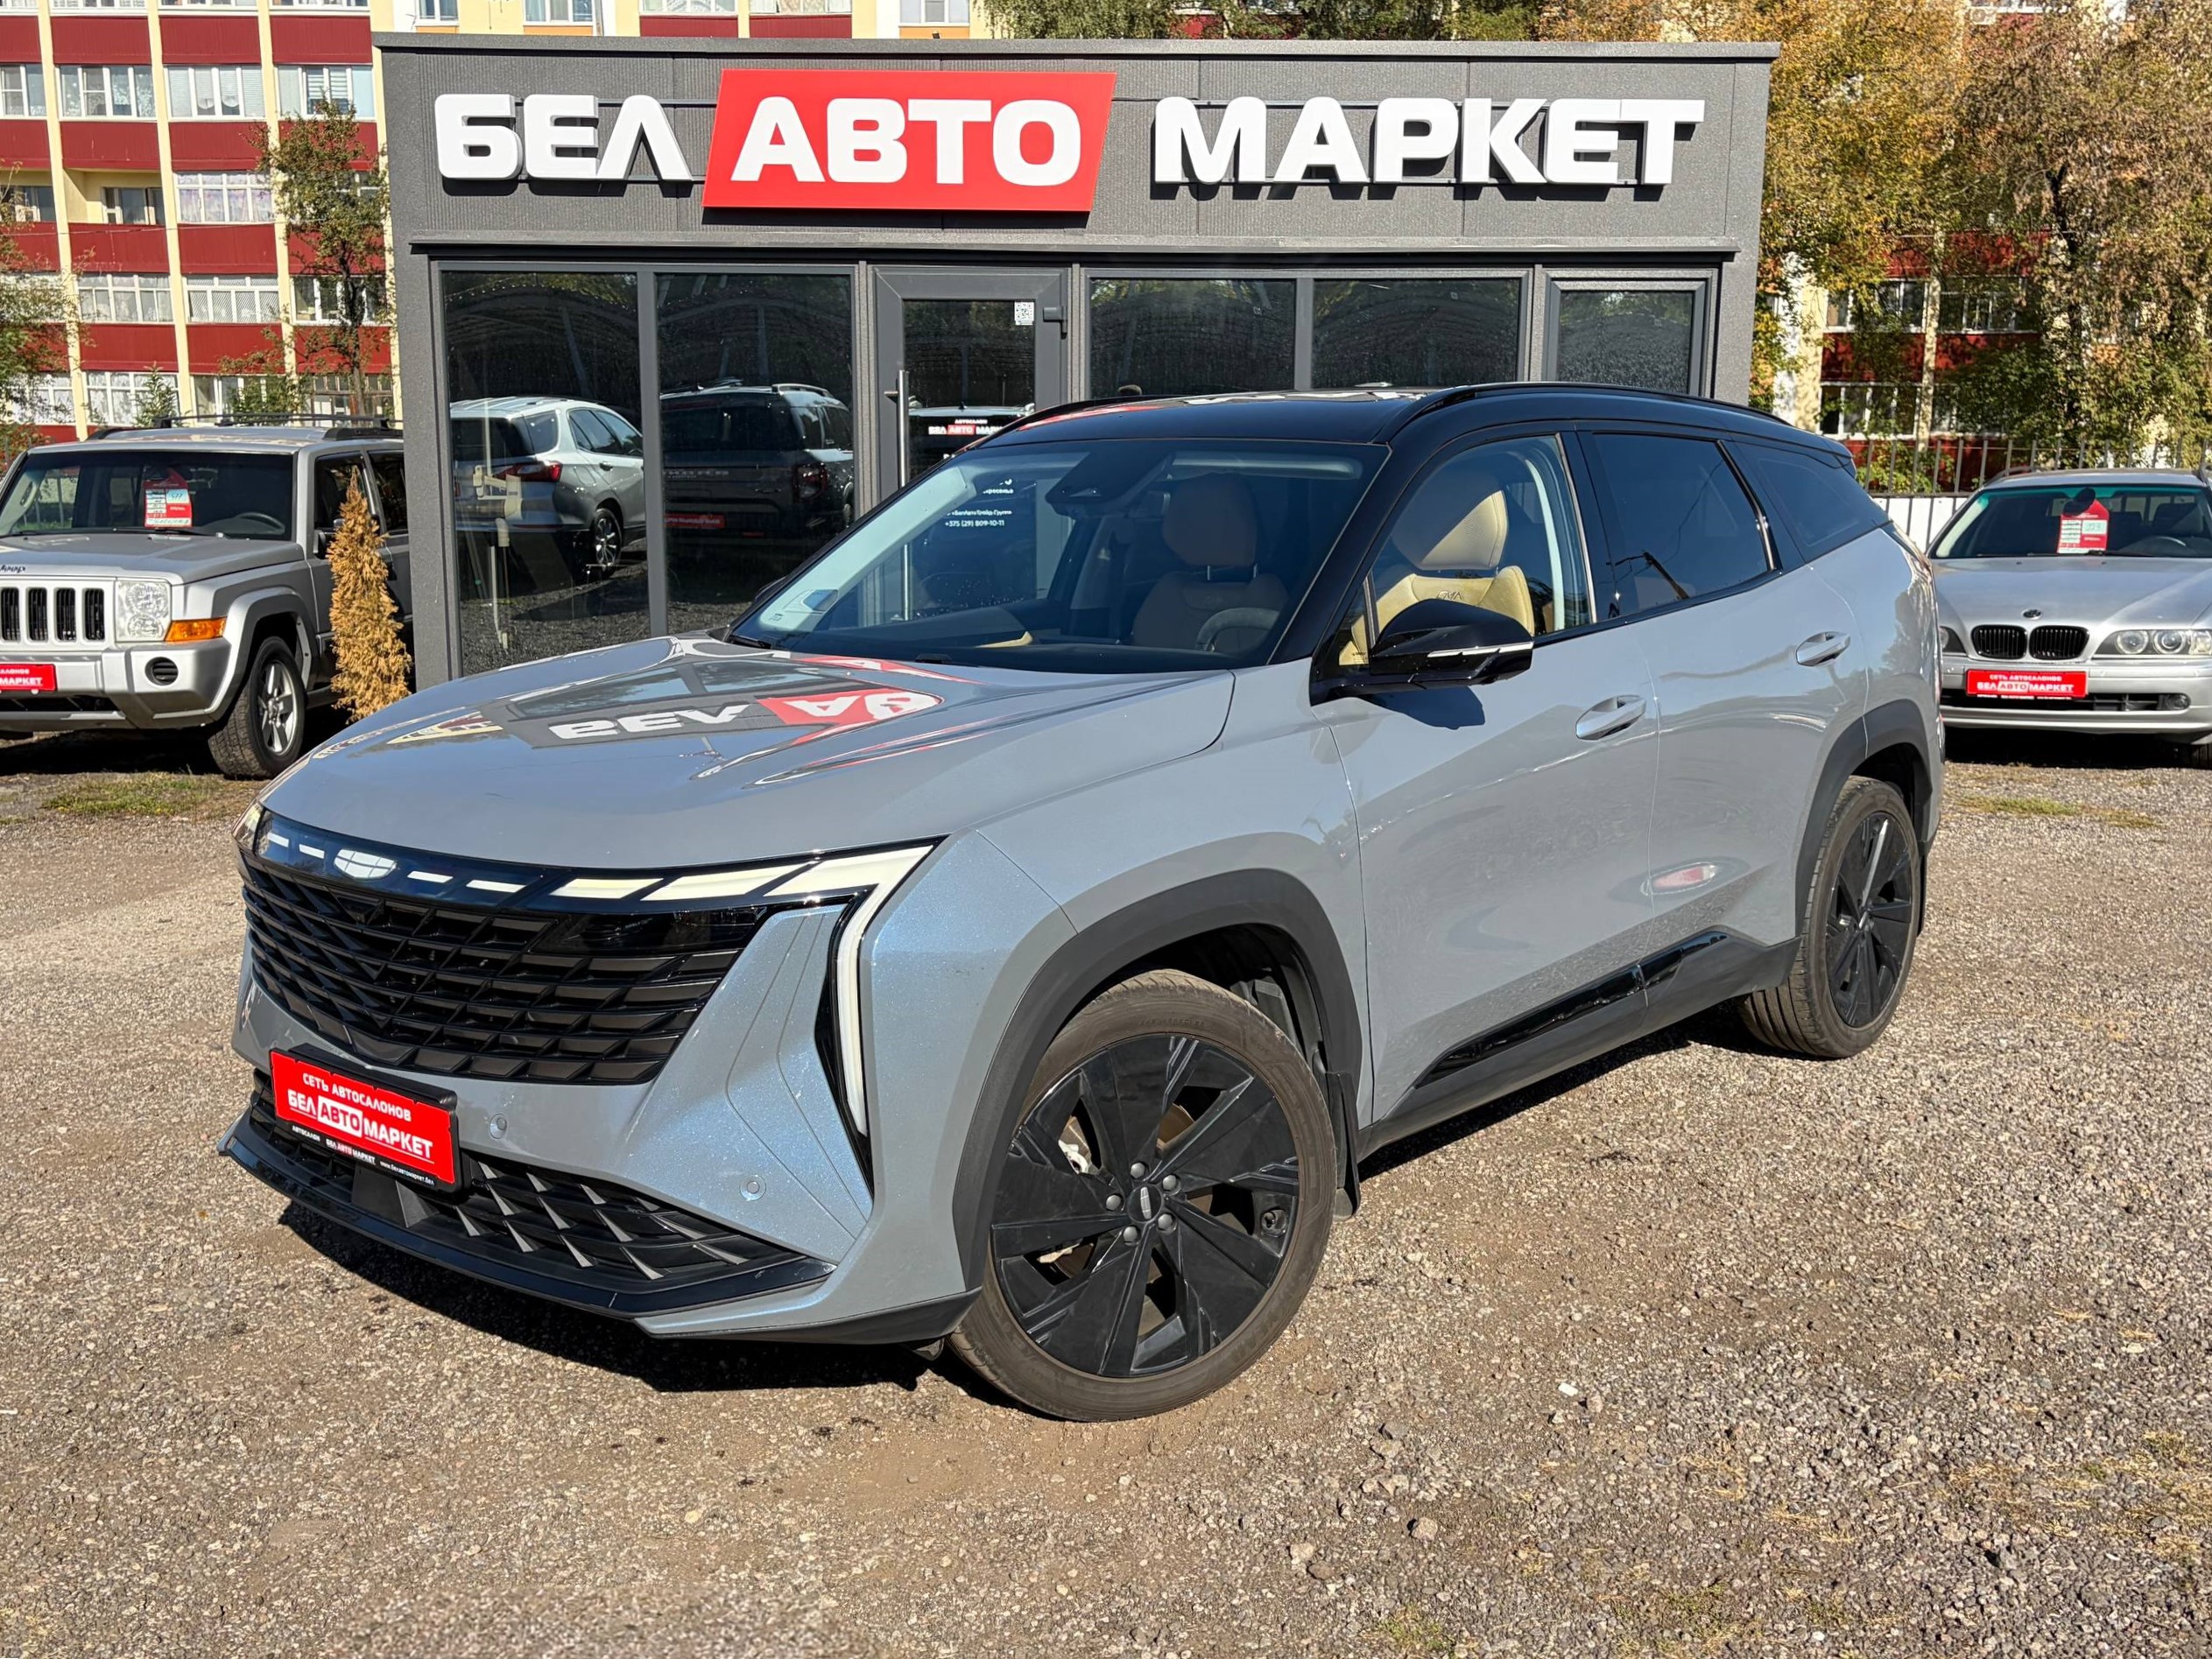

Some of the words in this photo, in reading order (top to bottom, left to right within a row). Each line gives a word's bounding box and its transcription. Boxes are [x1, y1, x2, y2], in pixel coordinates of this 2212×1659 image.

[435, 94, 694, 182] БЕЛ
[730, 95, 1081, 186] АВТО
[1154, 95, 1706, 185] МАРКЕТ
[1976, 681, 1998, 692] БЕЛ
[1999, 682, 2028, 691] АВТО
[2029, 683, 2075, 692] МАРКЕТ
[302, 1072, 329, 1093] СЕТЬ
[331, 1083, 412, 1122] АВТОСАЛОНОВ
[287, 1088, 317, 1116] БЕЛ
[320, 1100, 361, 1131] АВТО
[363, 1117, 433, 1159] МАРКЕТ
[352, 1149, 377, 1166] МАРКЕТ
